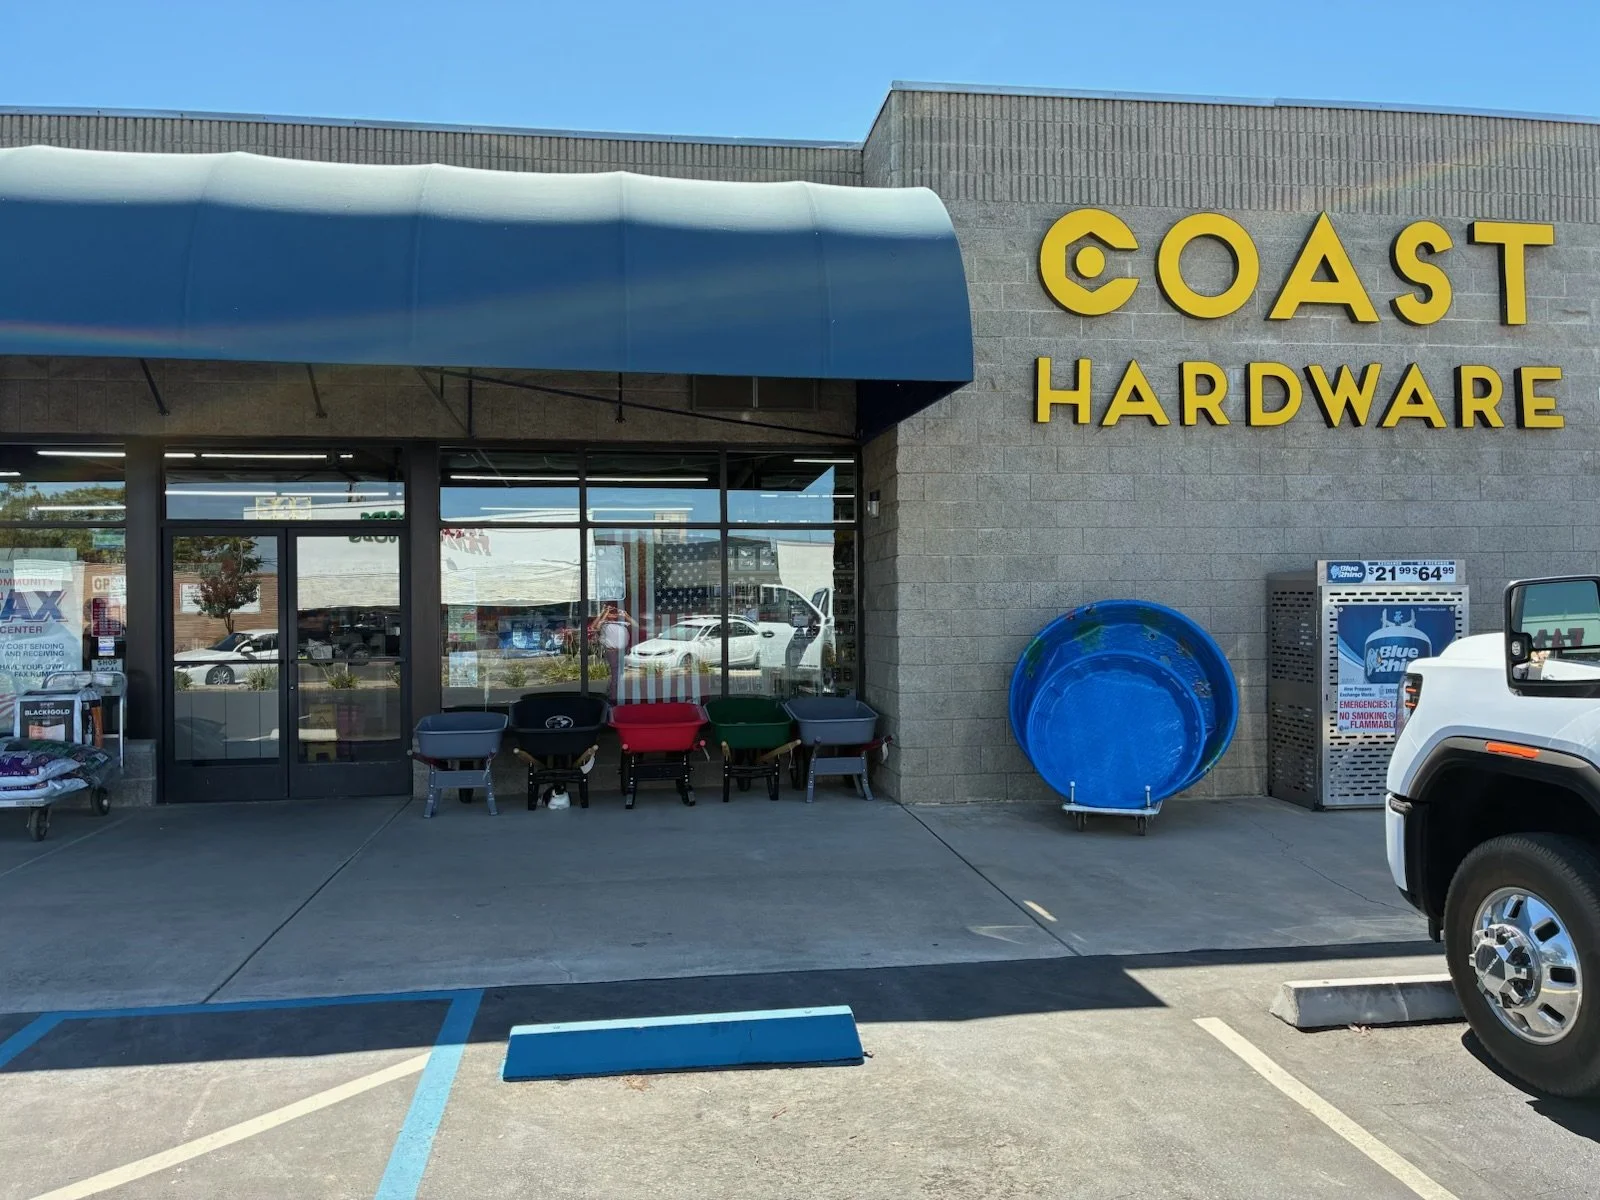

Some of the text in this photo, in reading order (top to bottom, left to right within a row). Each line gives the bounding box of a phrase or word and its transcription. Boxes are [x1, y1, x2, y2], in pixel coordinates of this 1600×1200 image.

[1039, 208, 1554, 326] COAST
[1033, 357, 1564, 429] HARDWARE
[0, 589, 68, 622] AX
[0, 626, 42, 634] CENTER
[1380, 645, 1419, 658] Blue
[1375, 658, 1408, 673] Rhi
[1339, 711, 1387, 720] NO SMOKING
